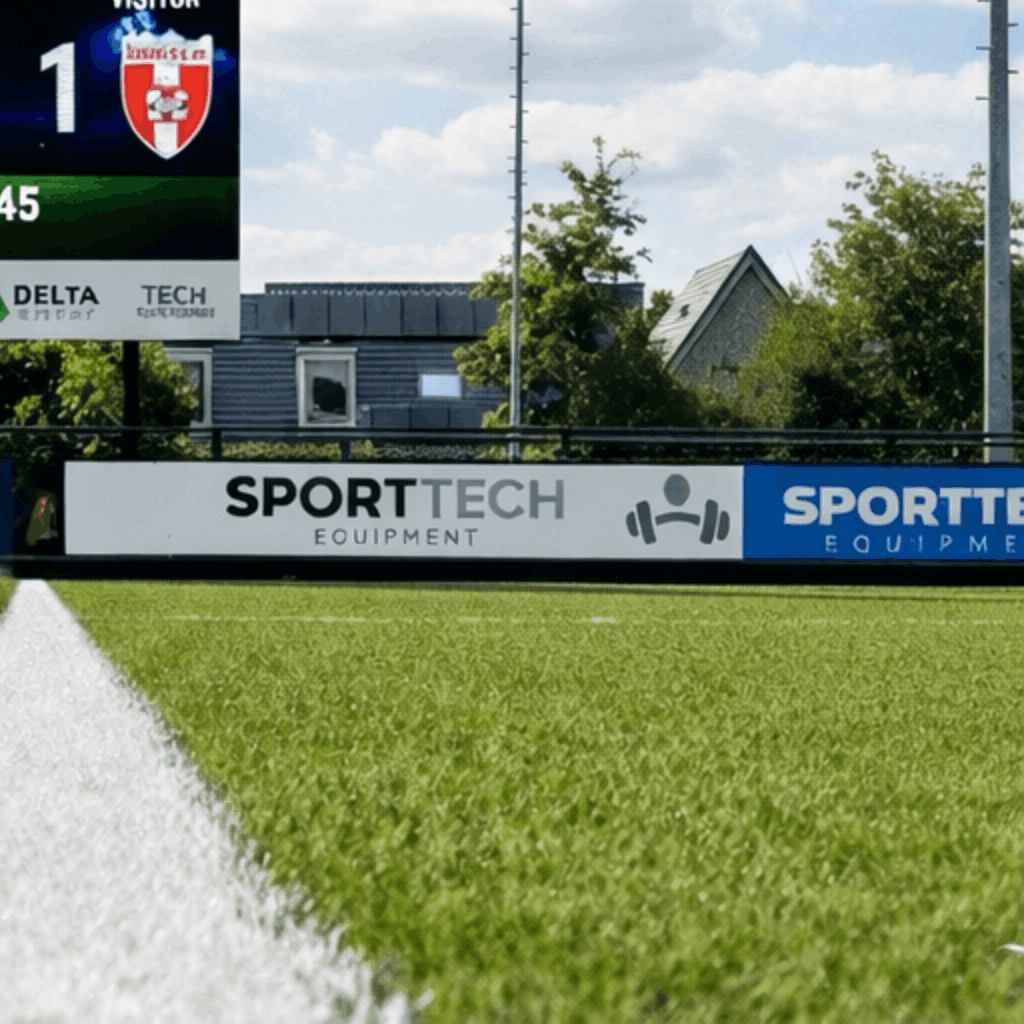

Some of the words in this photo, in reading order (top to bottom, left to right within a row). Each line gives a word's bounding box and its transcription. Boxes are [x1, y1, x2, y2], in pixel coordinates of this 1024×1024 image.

[40, 41, 75, 133] 1
[13, 284, 99, 305] DELTA
[140, 285, 206, 305] TECH
[225, 475, 564, 519] SPORTTECH
[314, 527, 479, 547] EQUIPMENT
